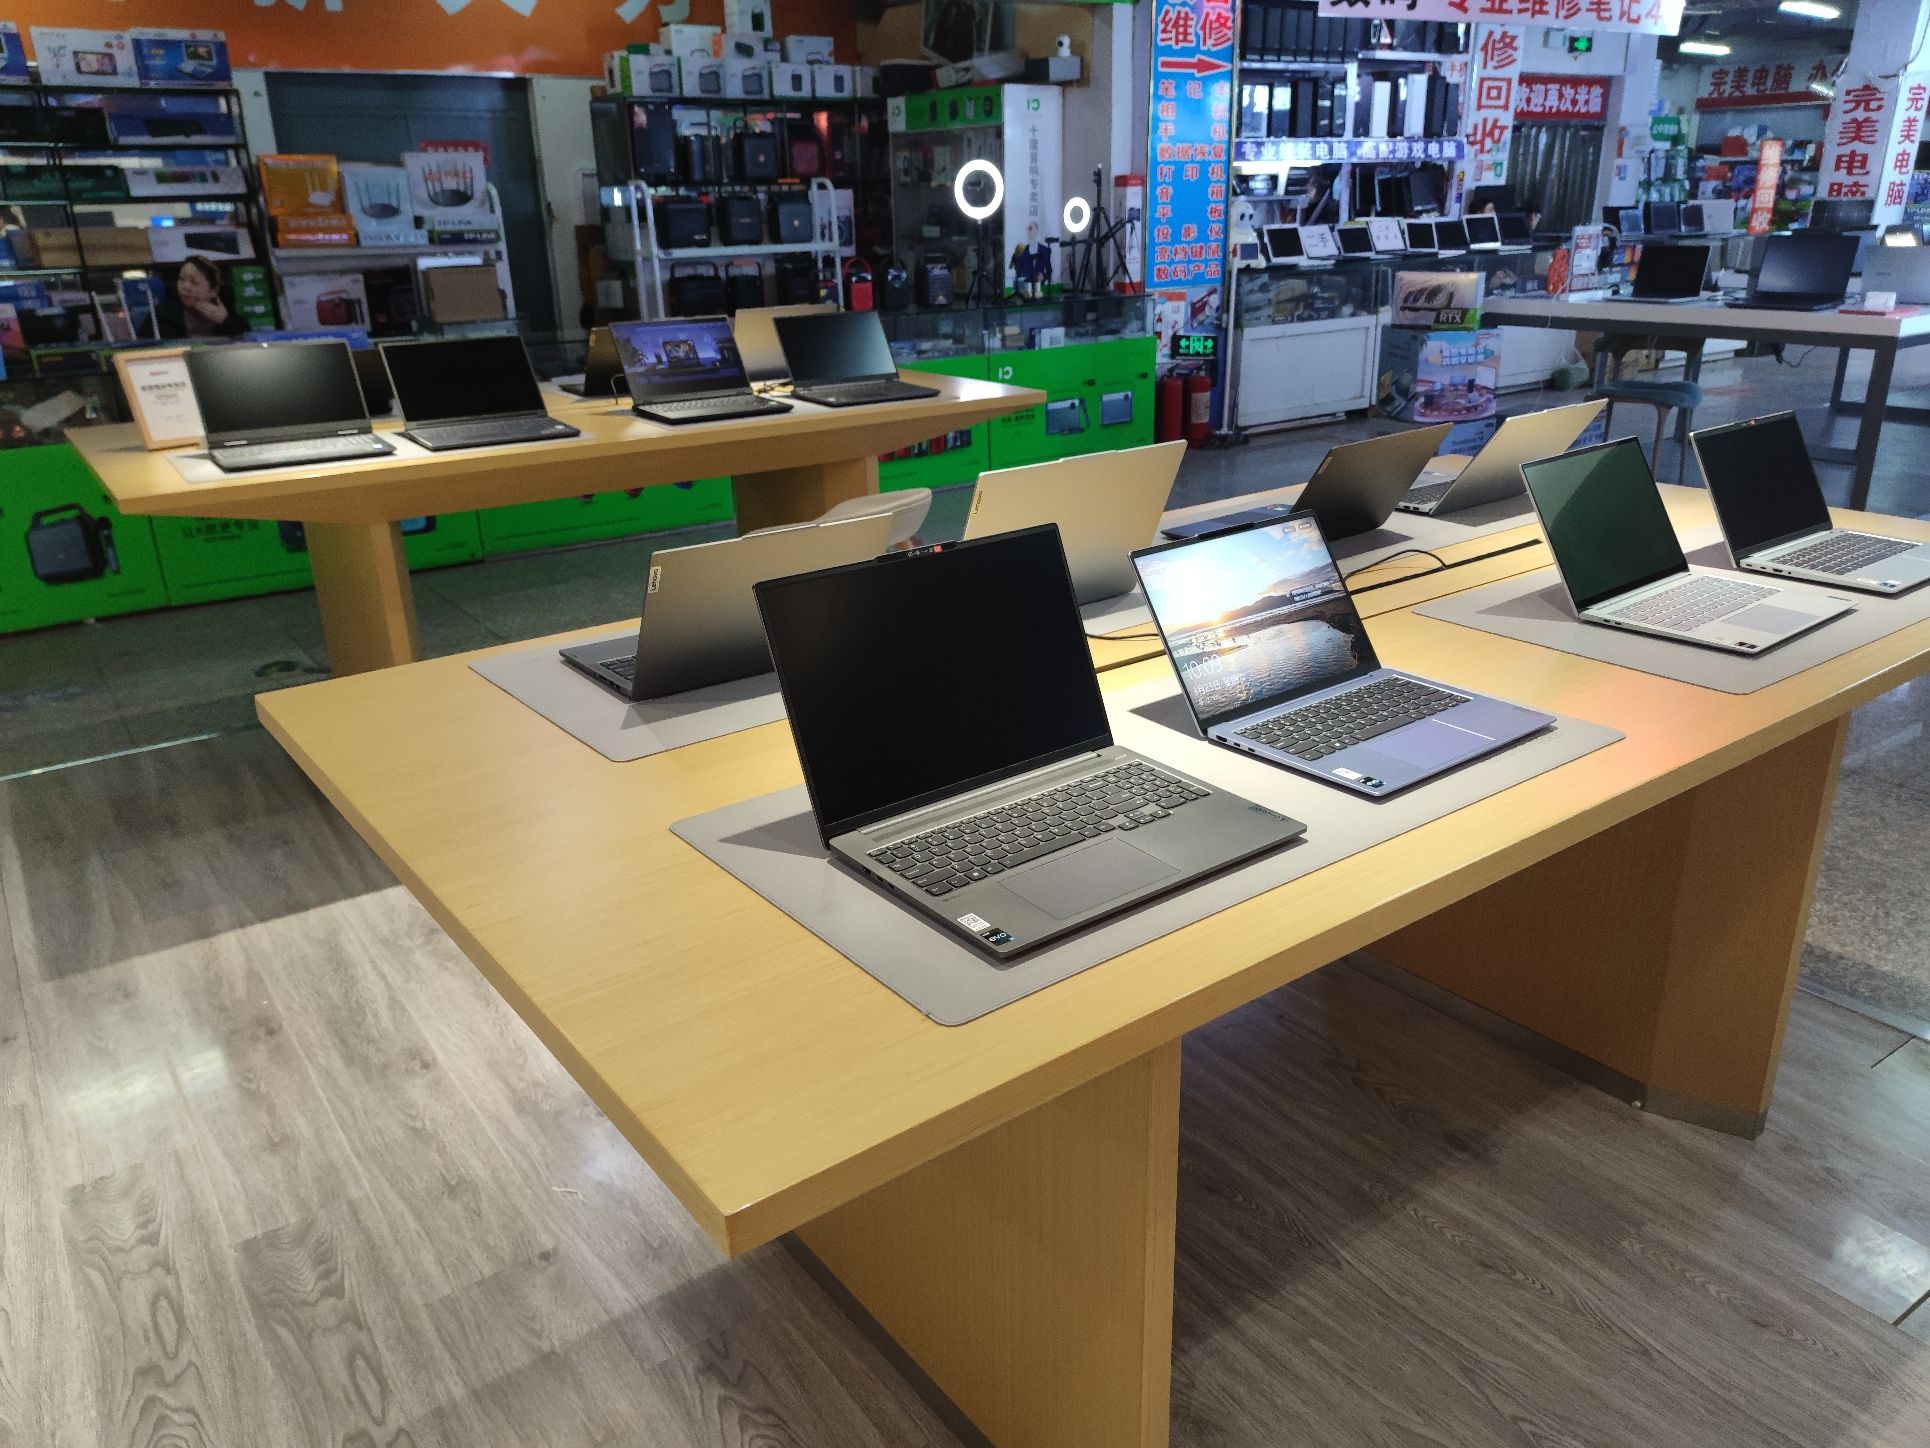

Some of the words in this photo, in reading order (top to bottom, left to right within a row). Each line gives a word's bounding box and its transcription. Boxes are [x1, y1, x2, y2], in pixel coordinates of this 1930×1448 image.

[1158, 6, 1234, 50] 维修
[1708, 64, 1795, 97] 完美电脑
[1516, 83, 1604, 113] 欢迎再次光临
[1158, 123, 1227, 141] 手机
[1157, 144, 1225, 161] 数据恢复
[1361, 141, 1457, 159] 高配游戏电脑
[1884, 83, 1928, 207] 完美电脑
[1157, 164, 1225, 181] 打印机
[1156, 184, 1225, 202] 音箱
[1156, 204, 1224, 222] 平板
[1155, 224, 1223, 241] 投影仪
[1155, 242, 1222, 261] 高档键鼠
[1154, 262, 1221, 281] 数码产品
[1439, 313, 1462, 323] RTX
[651, 568, 659, 591] Lenovo
[1182, 654, 1223, 681] 10:09
[988, 932, 1007, 942] evo
